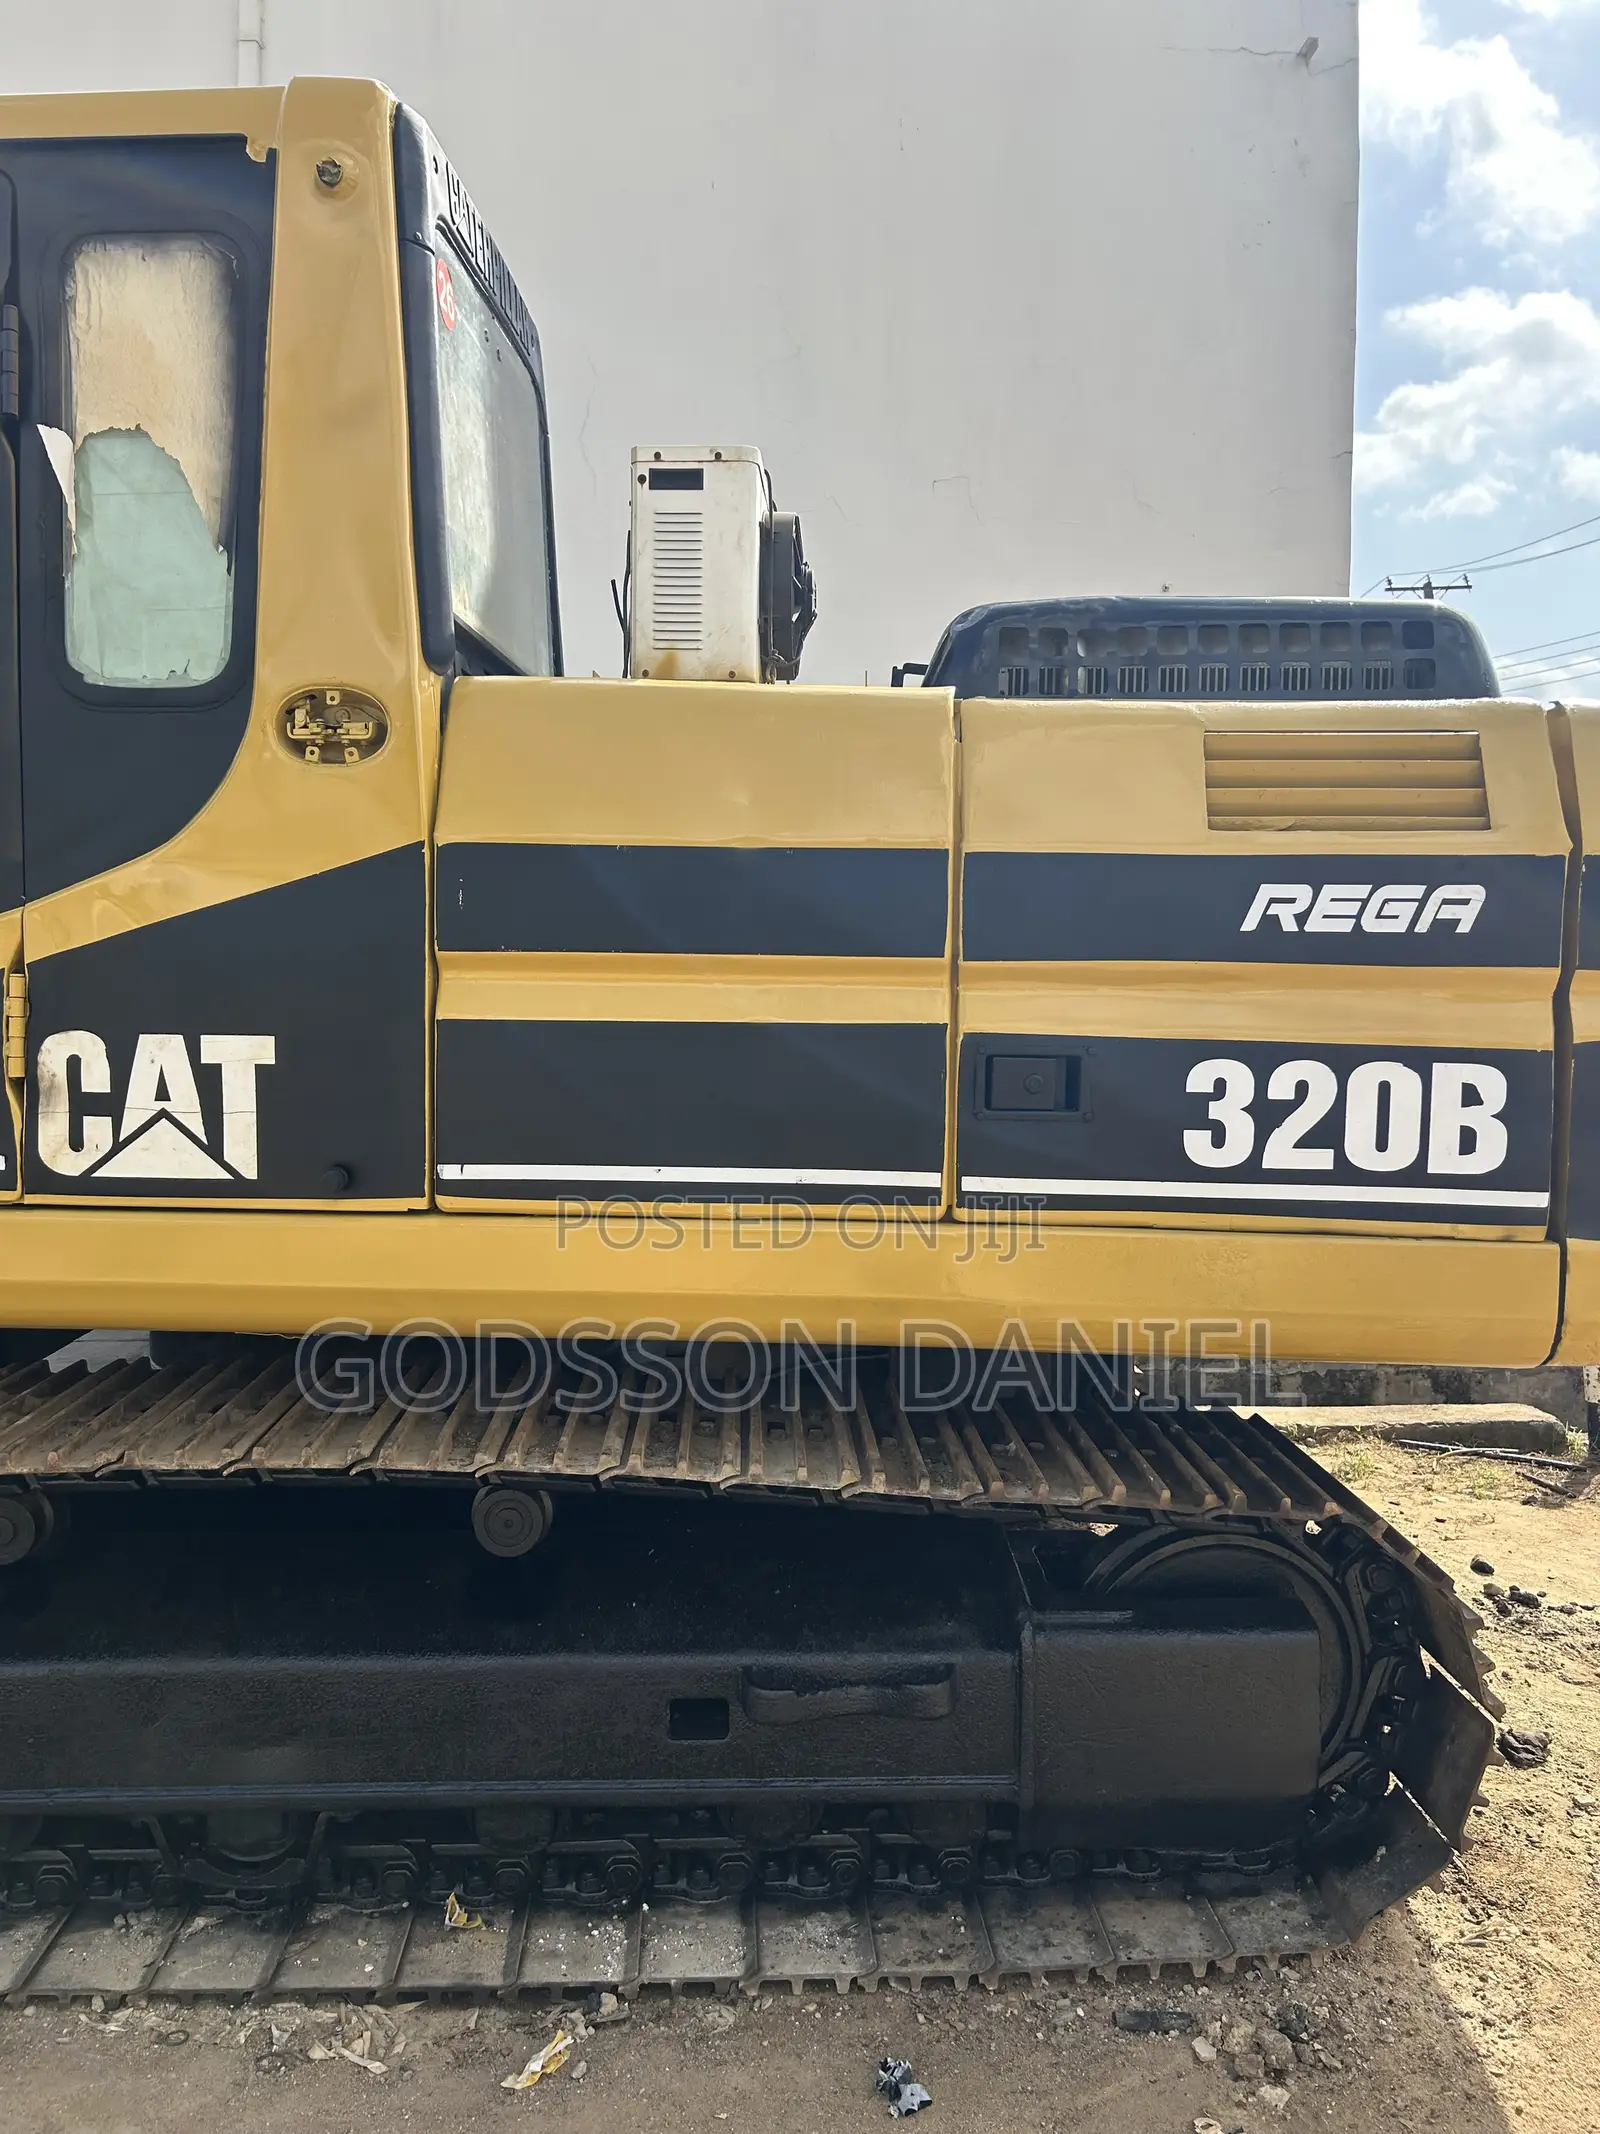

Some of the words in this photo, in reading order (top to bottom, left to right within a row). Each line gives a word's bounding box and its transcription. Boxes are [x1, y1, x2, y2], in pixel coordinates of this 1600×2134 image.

[438, 269, 455, 321] 26
[1240, 883, 1487, 933] REGA
[37, 1029, 276, 1180] CAT
[1183, 1058, 1508, 1175] 320B
